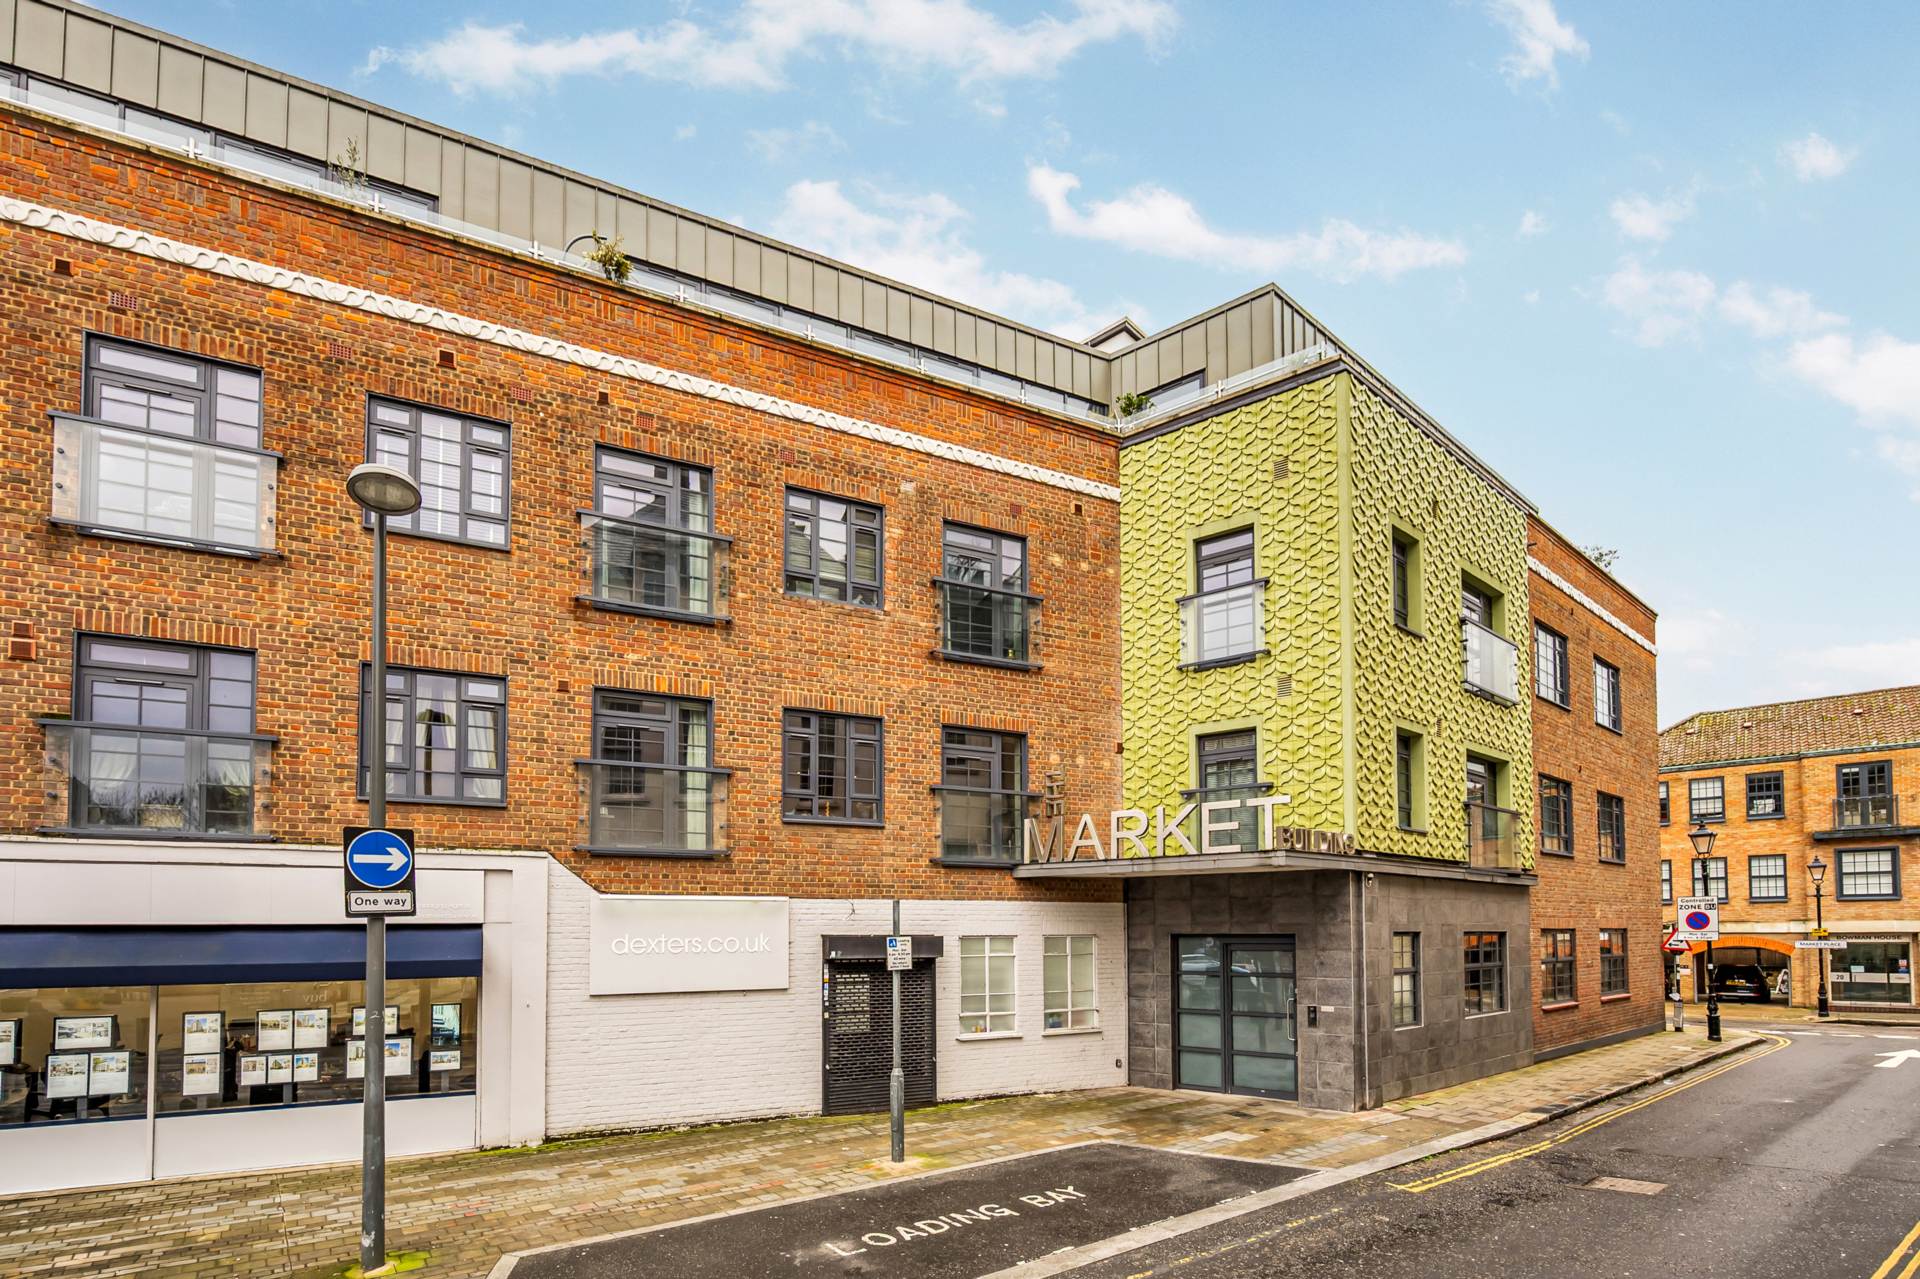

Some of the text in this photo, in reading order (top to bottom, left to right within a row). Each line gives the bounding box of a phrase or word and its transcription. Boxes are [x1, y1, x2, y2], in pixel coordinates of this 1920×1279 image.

[1023, 795, 1291, 864] MARKET
[354, 896, 407, 907] One way
[611, 933, 771, 954] dexters.co.uk
[825, 1185, 1087, 1256] LOADING BAY
